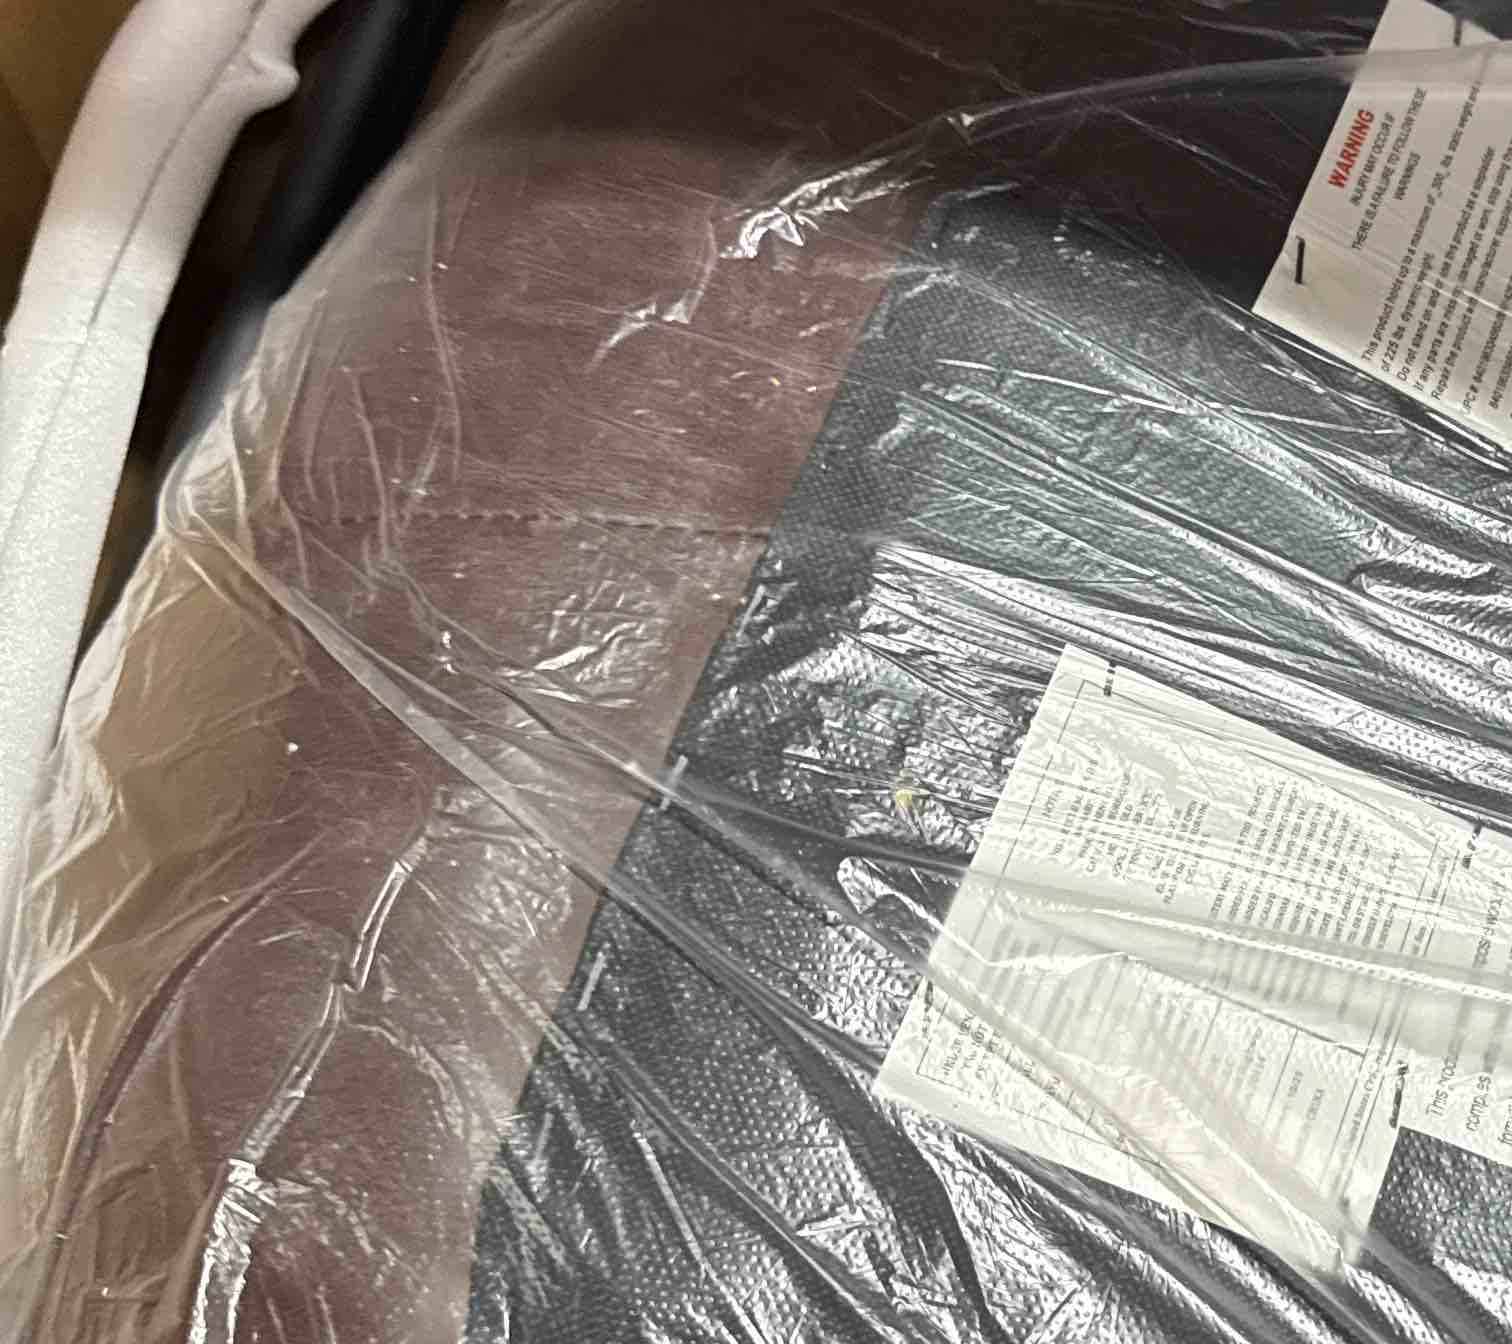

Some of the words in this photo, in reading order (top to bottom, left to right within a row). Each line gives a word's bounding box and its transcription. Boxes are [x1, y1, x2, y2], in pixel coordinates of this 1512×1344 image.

[1404, 86, 1428, 117] THESE
[1383, 111, 1397, 123] IF
[1456, 101, 1475, 129] weight
[1369, 119, 1394, 155] OCCUR
[1390, 113, 1417, 154] FOLLOW
[1326, 107, 1376, 189] WARNING
[1385, 151, 1400, 166] TO
[1361, 152, 1381, 175] MAY
[1369, 164, 1396, 203] FAILURE
[1391, 151, 1422, 201] WARNINGS
[1493, 162, 1512, 188] using
[1346, 172, 1372, 207] INJURY
[1424, 194, 1437, 206] of
[1485, 185, 1502, 207] stop
[1362, 207, 1377, 220] IS
[1366, 198, 1380, 210] A
[1465, 198, 1476, 210] as
[1349, 218, 1373, 250] THERE
[1408, 204, 1433, 248] maximum
[1450, 208, 1473, 245] product
[1473, 230, 1485, 242] or
[1400, 253, 1414, 265] to
[1443, 242, 1459, 262] this
[1457, 240, 1482, 284] damaged
[1394, 264, 1411, 285] up
[1471, 236, 1502, 295] manufacturer
[1384, 282, 1403, 304] holds
[1399, 282, 1423, 323] dynamic
[1369, 302, 1396, 342] product
[1421, 307, 1434, 321] on
[1409, 319, 1429, 348] stand
[1436, 320, 1450, 338] are
[1450, 312, 1474, 351] product
[1361, 340, 1379, 362] This
[1383, 340, 1400, 362] 225
[1402, 347, 1418, 366] not
[1425, 337, 1444, 364] parts
[1443, 349, 1458, 367] the
[1380, 359, 1393, 372] of
[1395, 365, 1411, 382] Do
[1418, 362, 1436, 384] any
[1413, 381, 1426, 391] If
[1430, 365, 1453, 400] Repair
[1423, 1087, 1449, 1118] This
